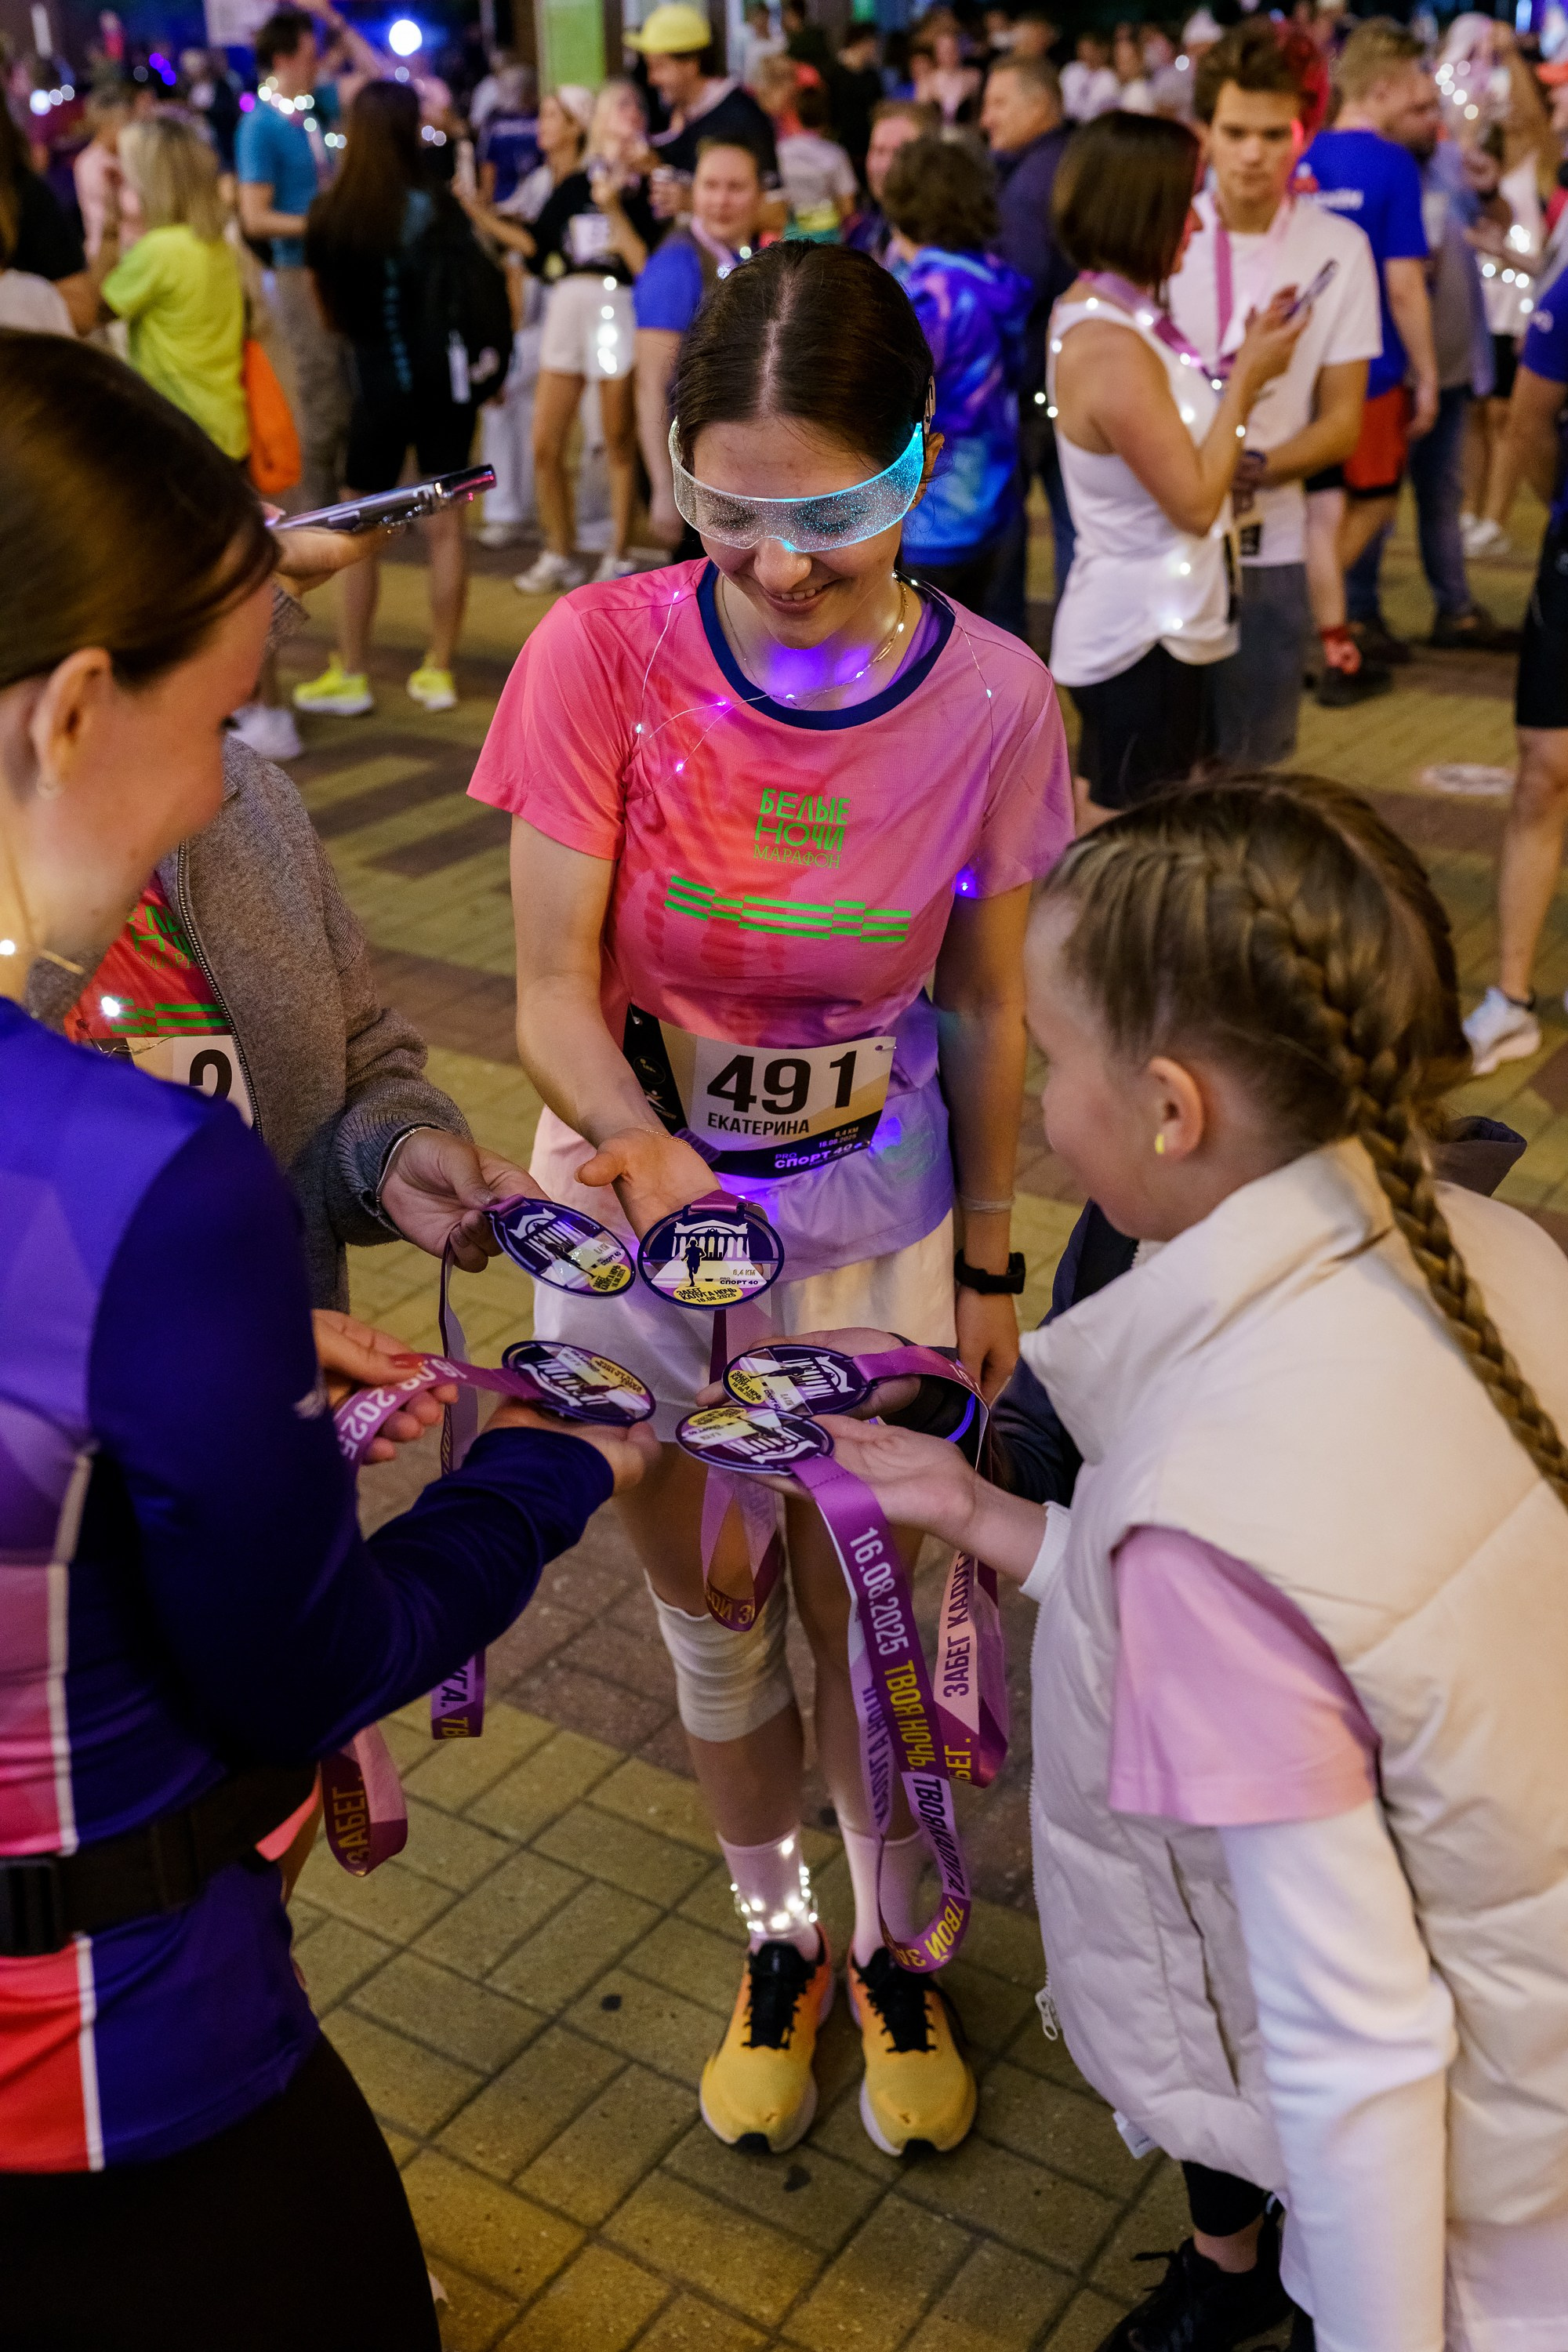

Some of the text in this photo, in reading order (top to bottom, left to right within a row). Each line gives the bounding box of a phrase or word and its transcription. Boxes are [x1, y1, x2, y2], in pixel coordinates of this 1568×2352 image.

[760, 787, 851, 825] БЕЛЫЕ
[754, 815, 846, 852] НОЧИ
[753, 844, 841, 869] МАРАФОН
[706, 1050, 858, 1116] 491
[707, 1112, 810, 1136] ЕКАТЕРИНА
[774, 1149, 831, 1169] СПОРТ
[775, 1152, 797, 1160] PRO
[677, 1287, 702, 1296] ЗАБЕГ
[713, 1287, 738, 1296] НОЧЬ
[849, 1526, 909, 1656] 16.08.2025
[943, 1551, 970, 1698] ЗАБЕГ КАЛУГ
[925, 1897, 964, 1962] ТВОЙ
